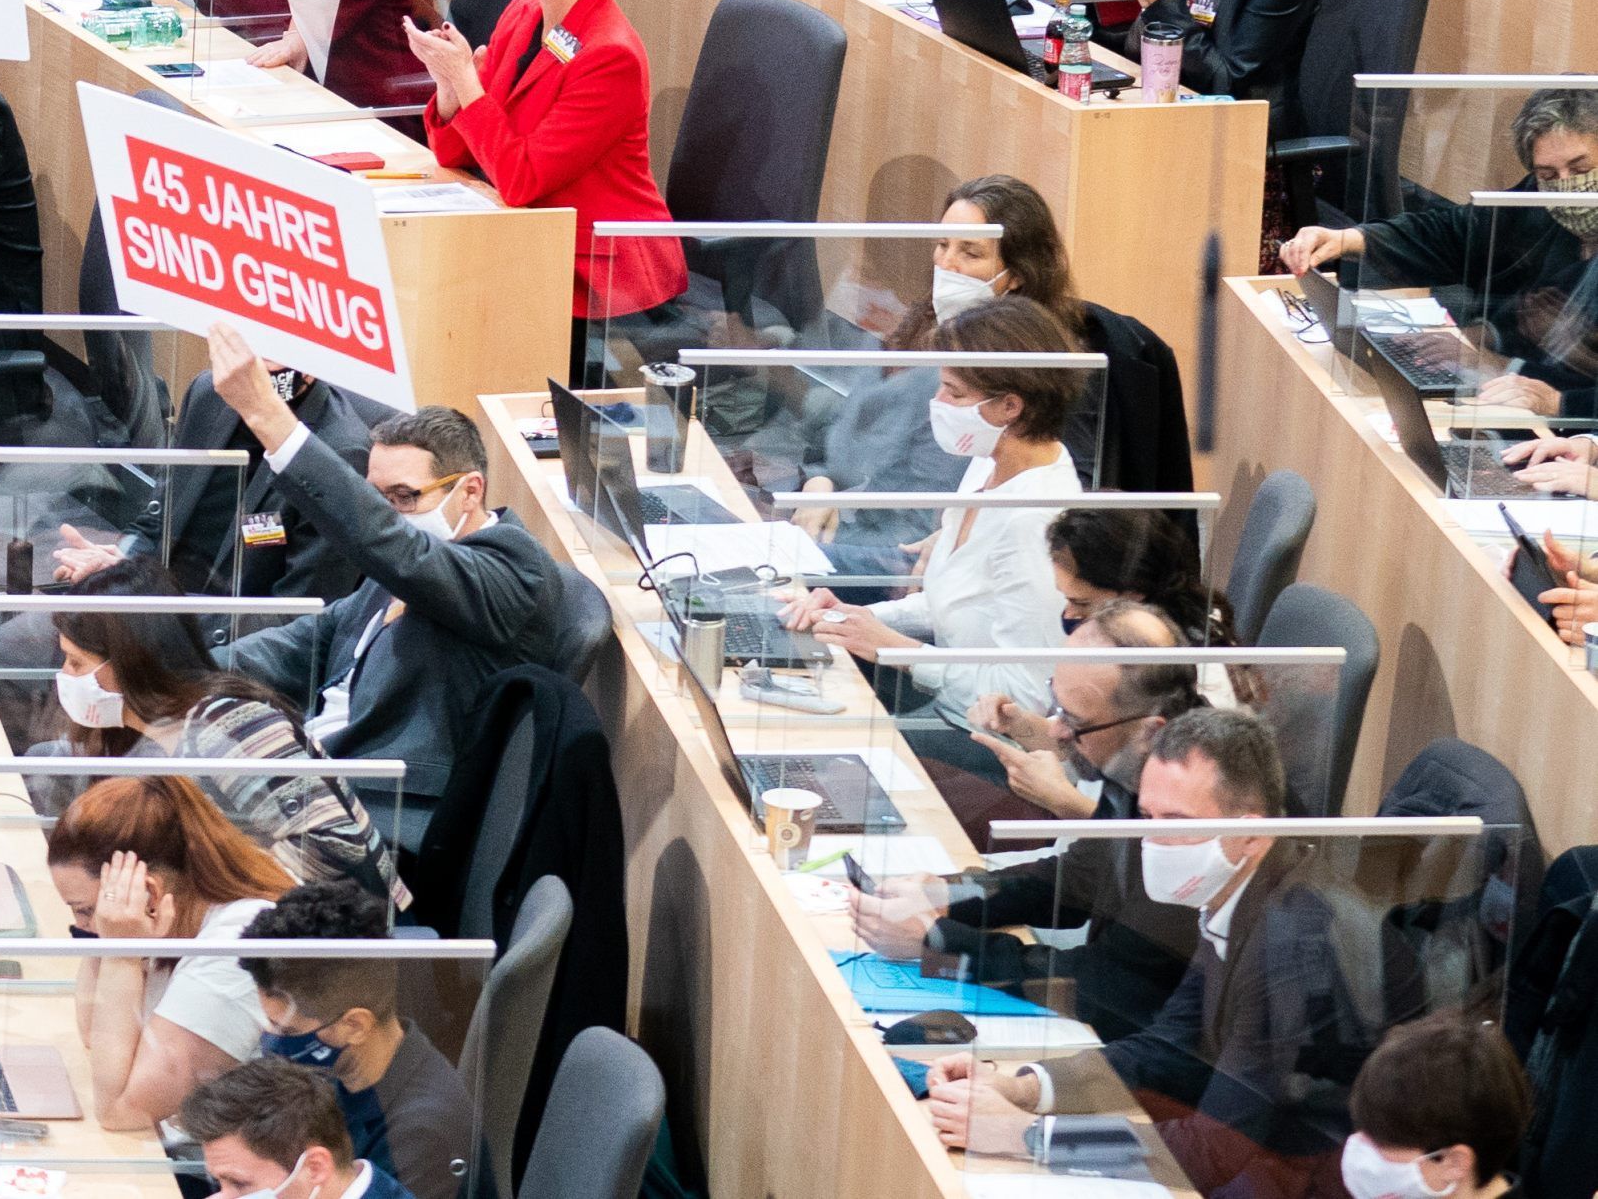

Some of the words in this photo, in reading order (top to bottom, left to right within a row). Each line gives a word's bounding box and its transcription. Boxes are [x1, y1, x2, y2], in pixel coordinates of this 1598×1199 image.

[142, 157, 191, 215] 45
[198, 175, 338, 268] JAHRE
[124, 216, 225, 291] SIND
[232, 253, 383, 351] GENUG
